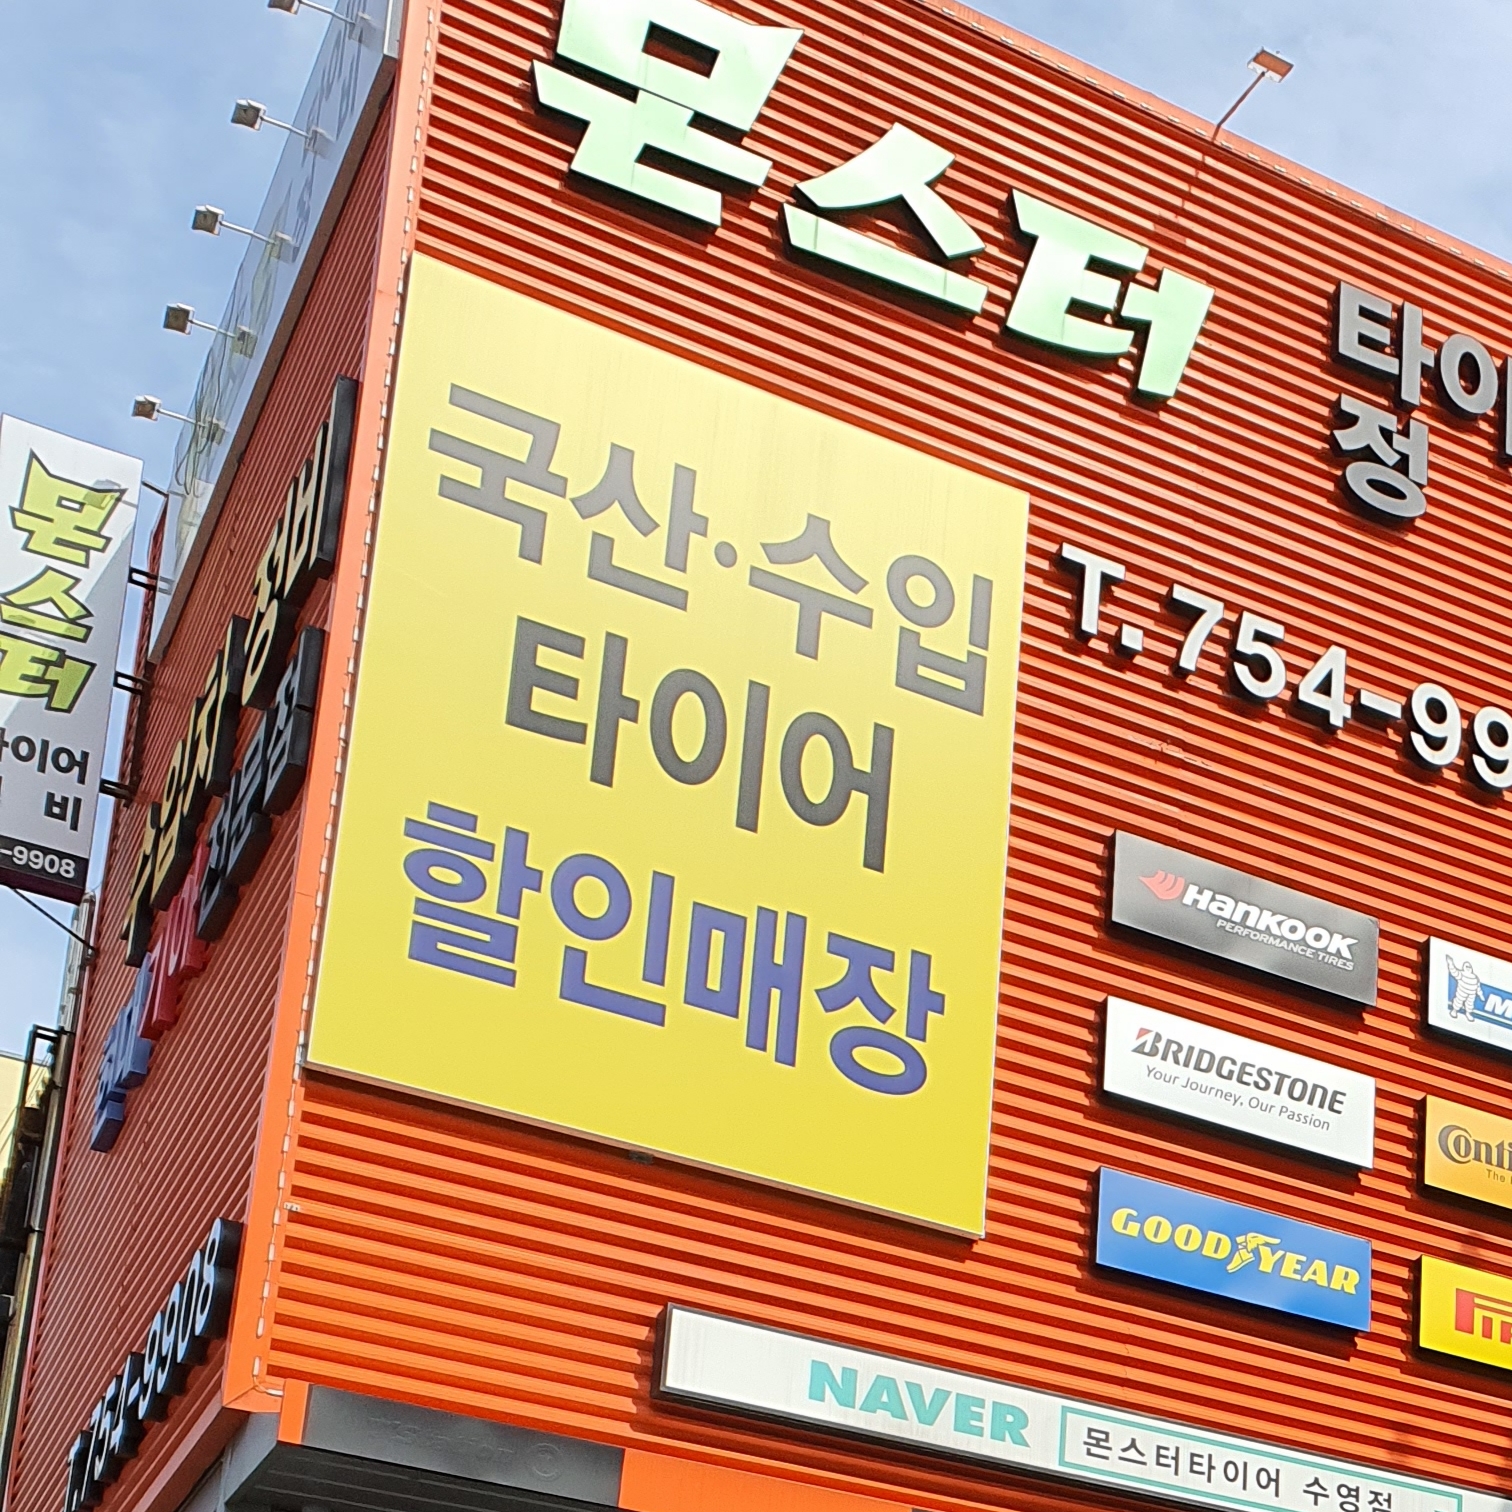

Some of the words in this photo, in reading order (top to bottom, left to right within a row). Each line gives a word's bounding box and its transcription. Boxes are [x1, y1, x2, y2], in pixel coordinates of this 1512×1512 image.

[531, 0, 1215, 398] 몬스터
[428, 381, 993, 716] 국산·수입
[0, 728, 91, 786] 이어
[505, 614, 895, 874] 타이어
[403, 801, 945, 1096] 할인매장
[1216, 919, 1314, 959] PERFORMANCE
[1317, 951, 1354, 971] TIRES
[1131, 1027, 1347, 1115] BRIDGESTONE
[1146, 1065, 1179, 1085] Your
[1181, 1077, 1244, 1107] Journey,
[1248, 1095, 1275, 1113] Our
[1278, 1105, 1330, 1131] Passion
[1486, 1168, 1506, 1183] The
[808, 1360, 1030, 1448] NAVER
[1082, 1427, 1281, 1499] 몬스터타이어
